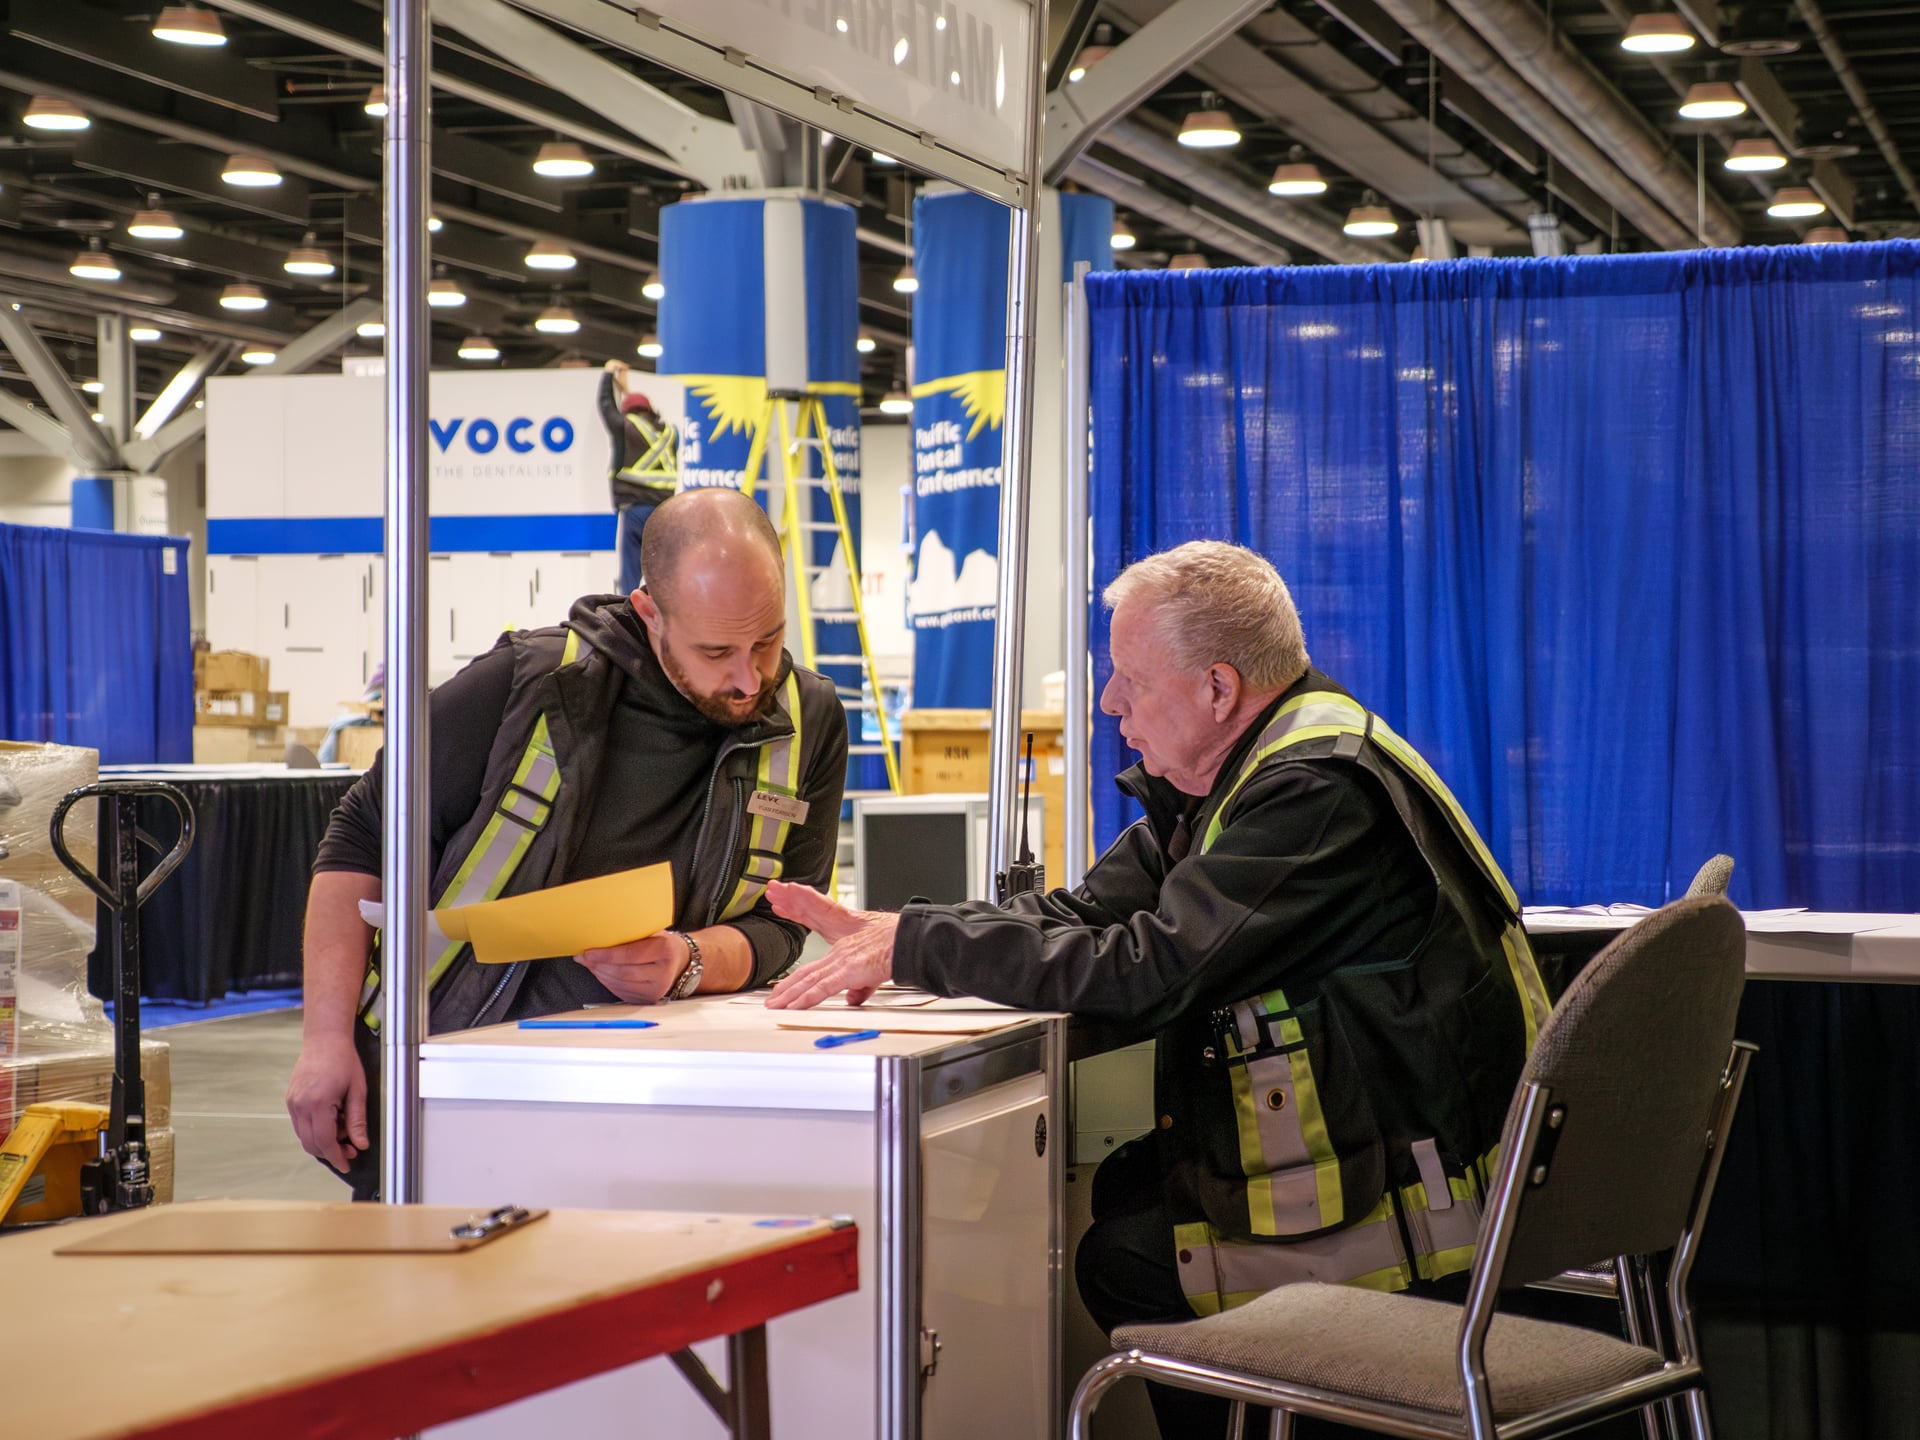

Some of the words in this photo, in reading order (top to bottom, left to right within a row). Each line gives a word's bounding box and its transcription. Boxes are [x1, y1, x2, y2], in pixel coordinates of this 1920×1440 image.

[429, 416, 574, 454] VOCO
[435, 466, 464, 478] THE
[472, 463, 573, 479] DENTALISTS
